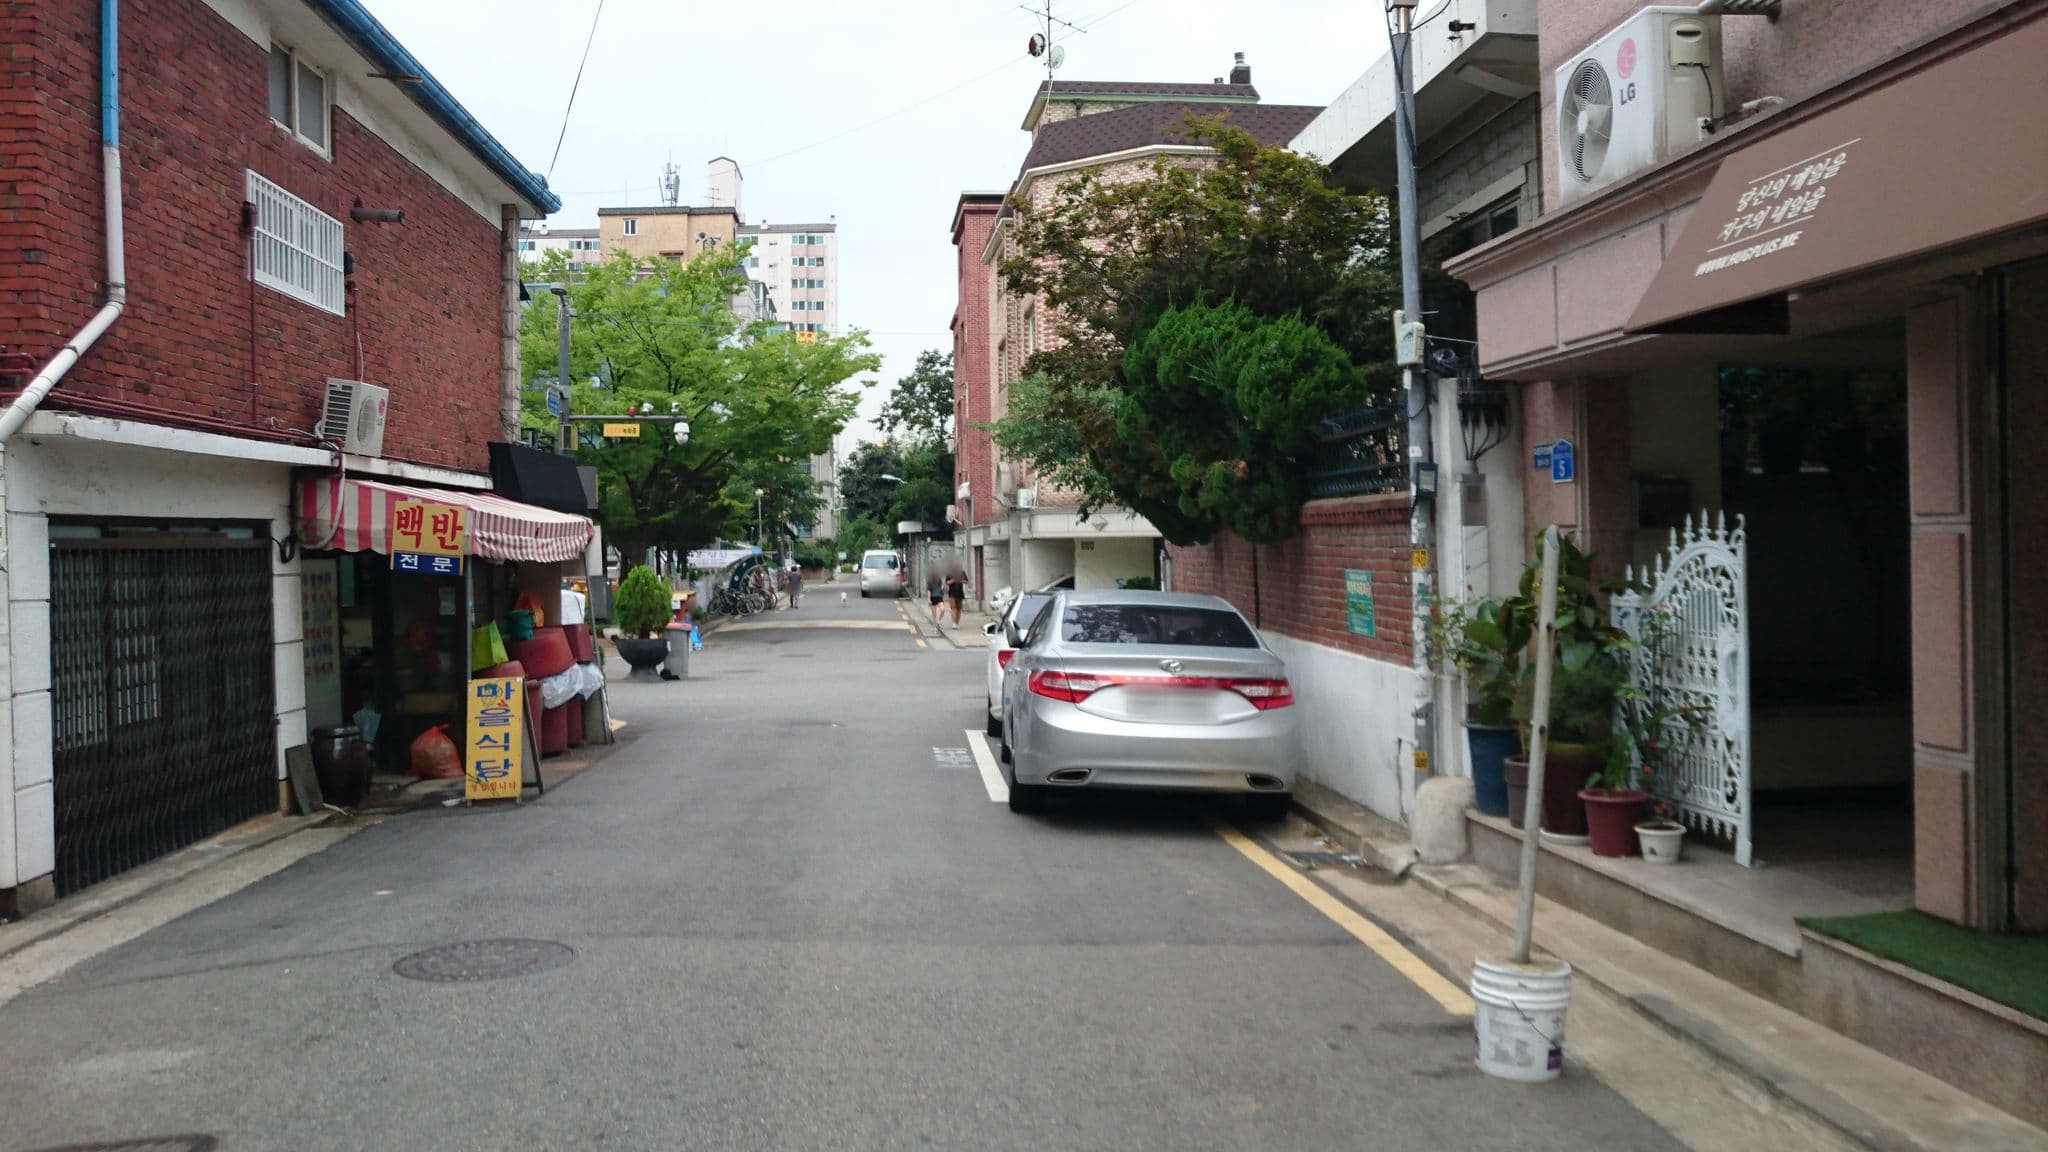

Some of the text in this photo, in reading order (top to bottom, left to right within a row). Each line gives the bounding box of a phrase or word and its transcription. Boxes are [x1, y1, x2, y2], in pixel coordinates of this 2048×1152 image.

[1619, 82, 1636, 106] LG
[1737, 174, 1791, 213] 당신의
[1771, 186, 1826, 224] 내일을
[1559, 459, 1566, 477] 5
[475, 681, 515, 778] 마을식당
